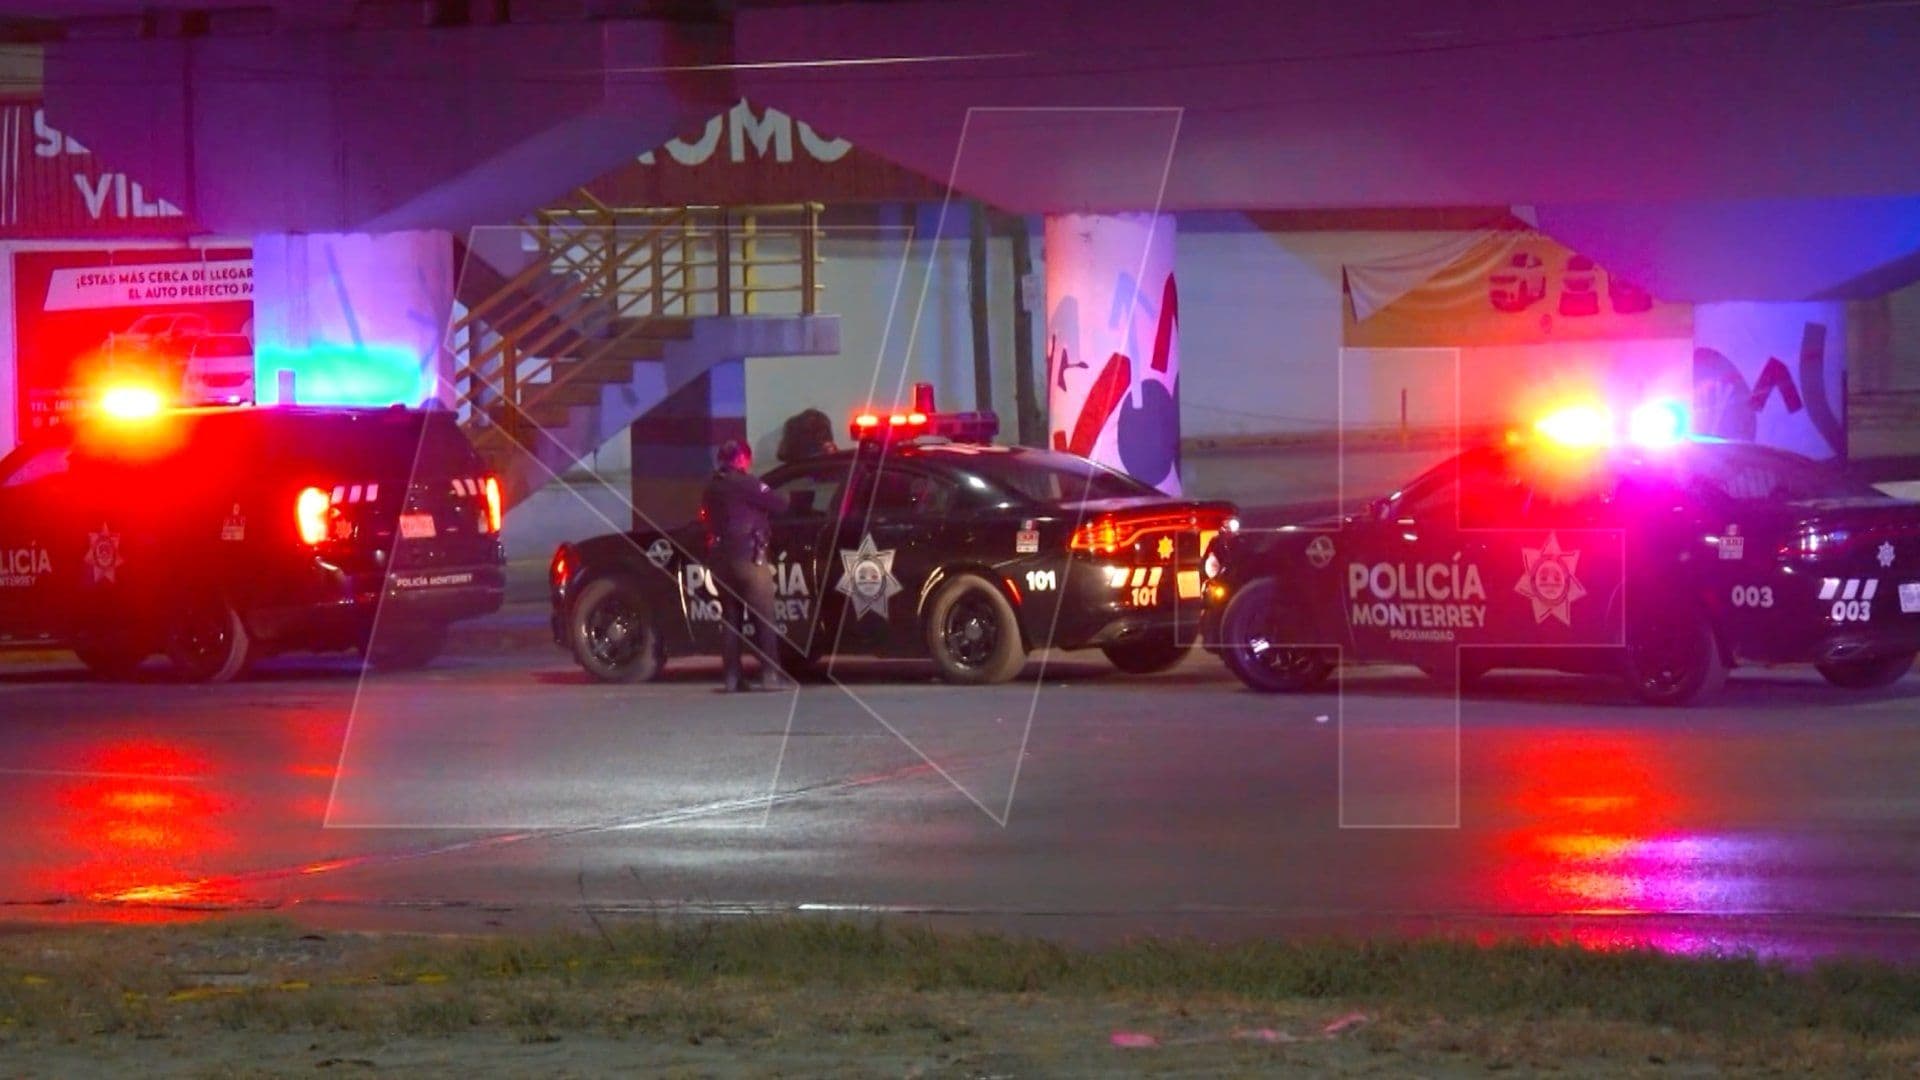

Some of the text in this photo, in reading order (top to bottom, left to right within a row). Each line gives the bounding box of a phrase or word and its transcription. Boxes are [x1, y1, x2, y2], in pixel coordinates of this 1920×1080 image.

[148, 269, 189, 284] CERCA
[210, 267, 254, 281] LLEGAR
[128, 288, 142, 300] EL
[145, 285, 178, 299] AUTO
[180, 283, 239, 297] PERFECTO
[1025, 569, 1057, 591] 101
[1349, 551, 1487, 600] POLICÍA
[1131, 587, 1157, 606] 101
[1731, 584, 1774, 607] 003
[1352, 603, 1487, 628] MONTERREY
[1831, 600, 1871, 621] 003
